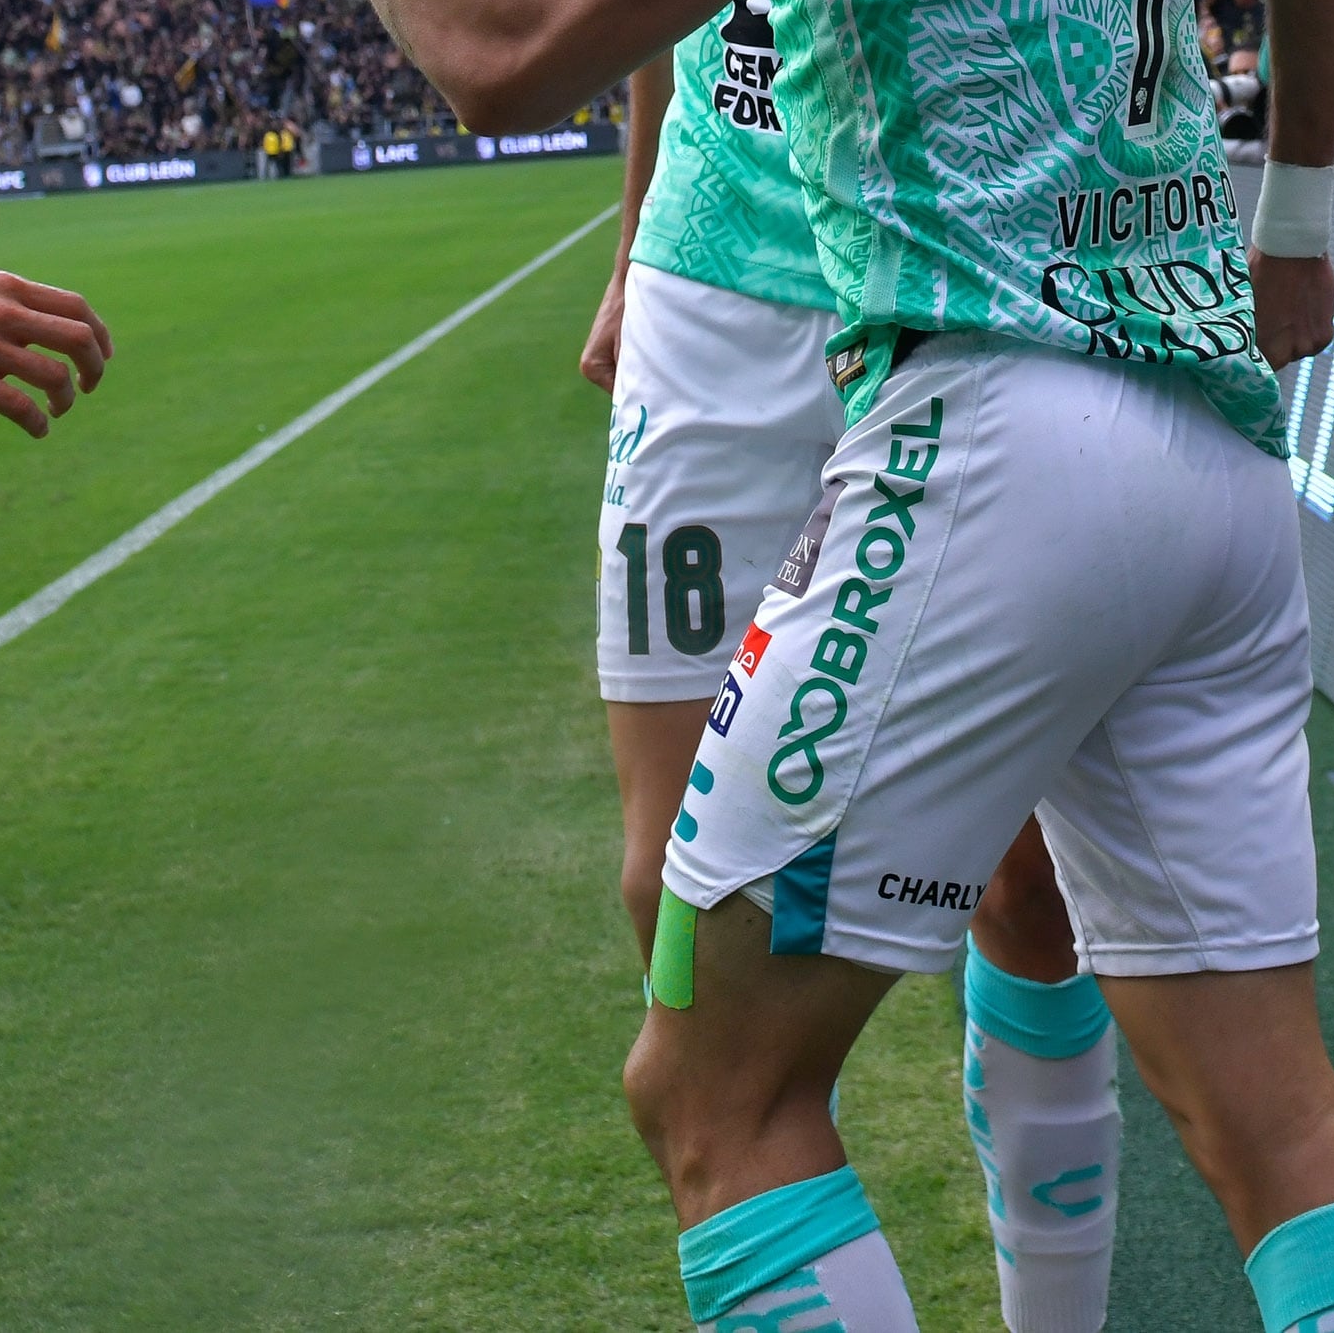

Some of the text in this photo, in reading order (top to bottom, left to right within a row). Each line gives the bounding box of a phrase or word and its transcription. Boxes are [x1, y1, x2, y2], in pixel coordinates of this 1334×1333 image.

[1057, 173, 1219, 248] VICTOR
[616, 523, 726, 656] 18
[810, 397, 945, 686] BROXEL
[877, 873, 988, 911] CHARLY
